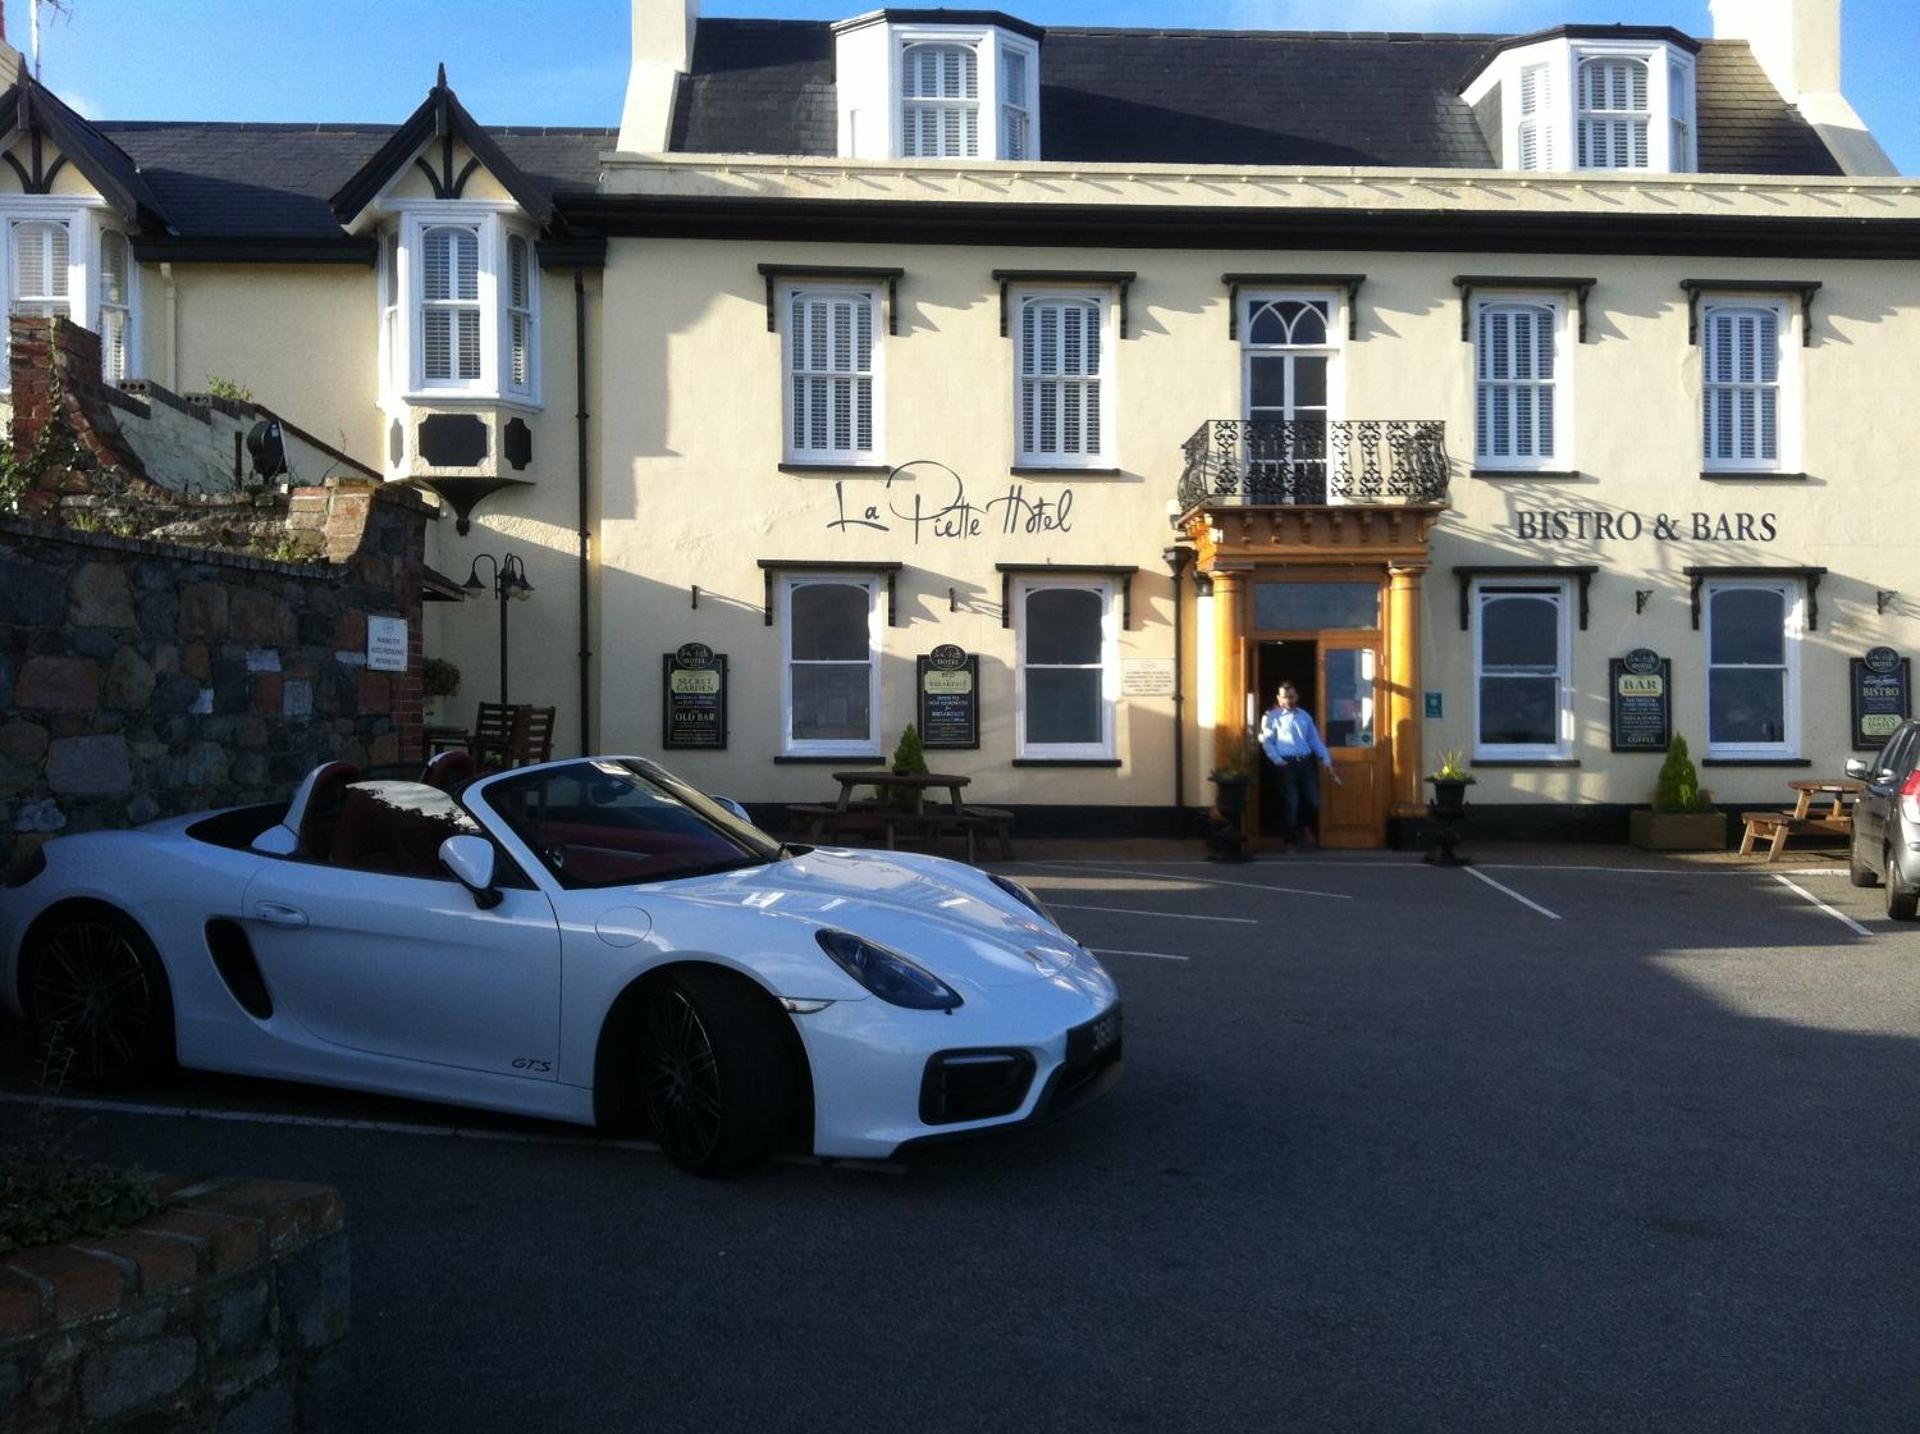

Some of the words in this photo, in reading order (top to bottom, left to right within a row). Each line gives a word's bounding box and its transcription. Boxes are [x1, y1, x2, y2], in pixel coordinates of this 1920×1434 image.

[826, 481, 889, 532] La
[886, 460, 988, 544] Piette
[986, 484, 1073, 534] Hotel
[1516, 510, 1642, 541] BISTRO
[1653, 512, 1681, 541] &
[1691, 511, 1777, 542] BARS
[1624, 680, 1657, 689] BAR
[1863, 687, 1900, 697] BISTRO
[511, 1058, 551, 1072] GTS
